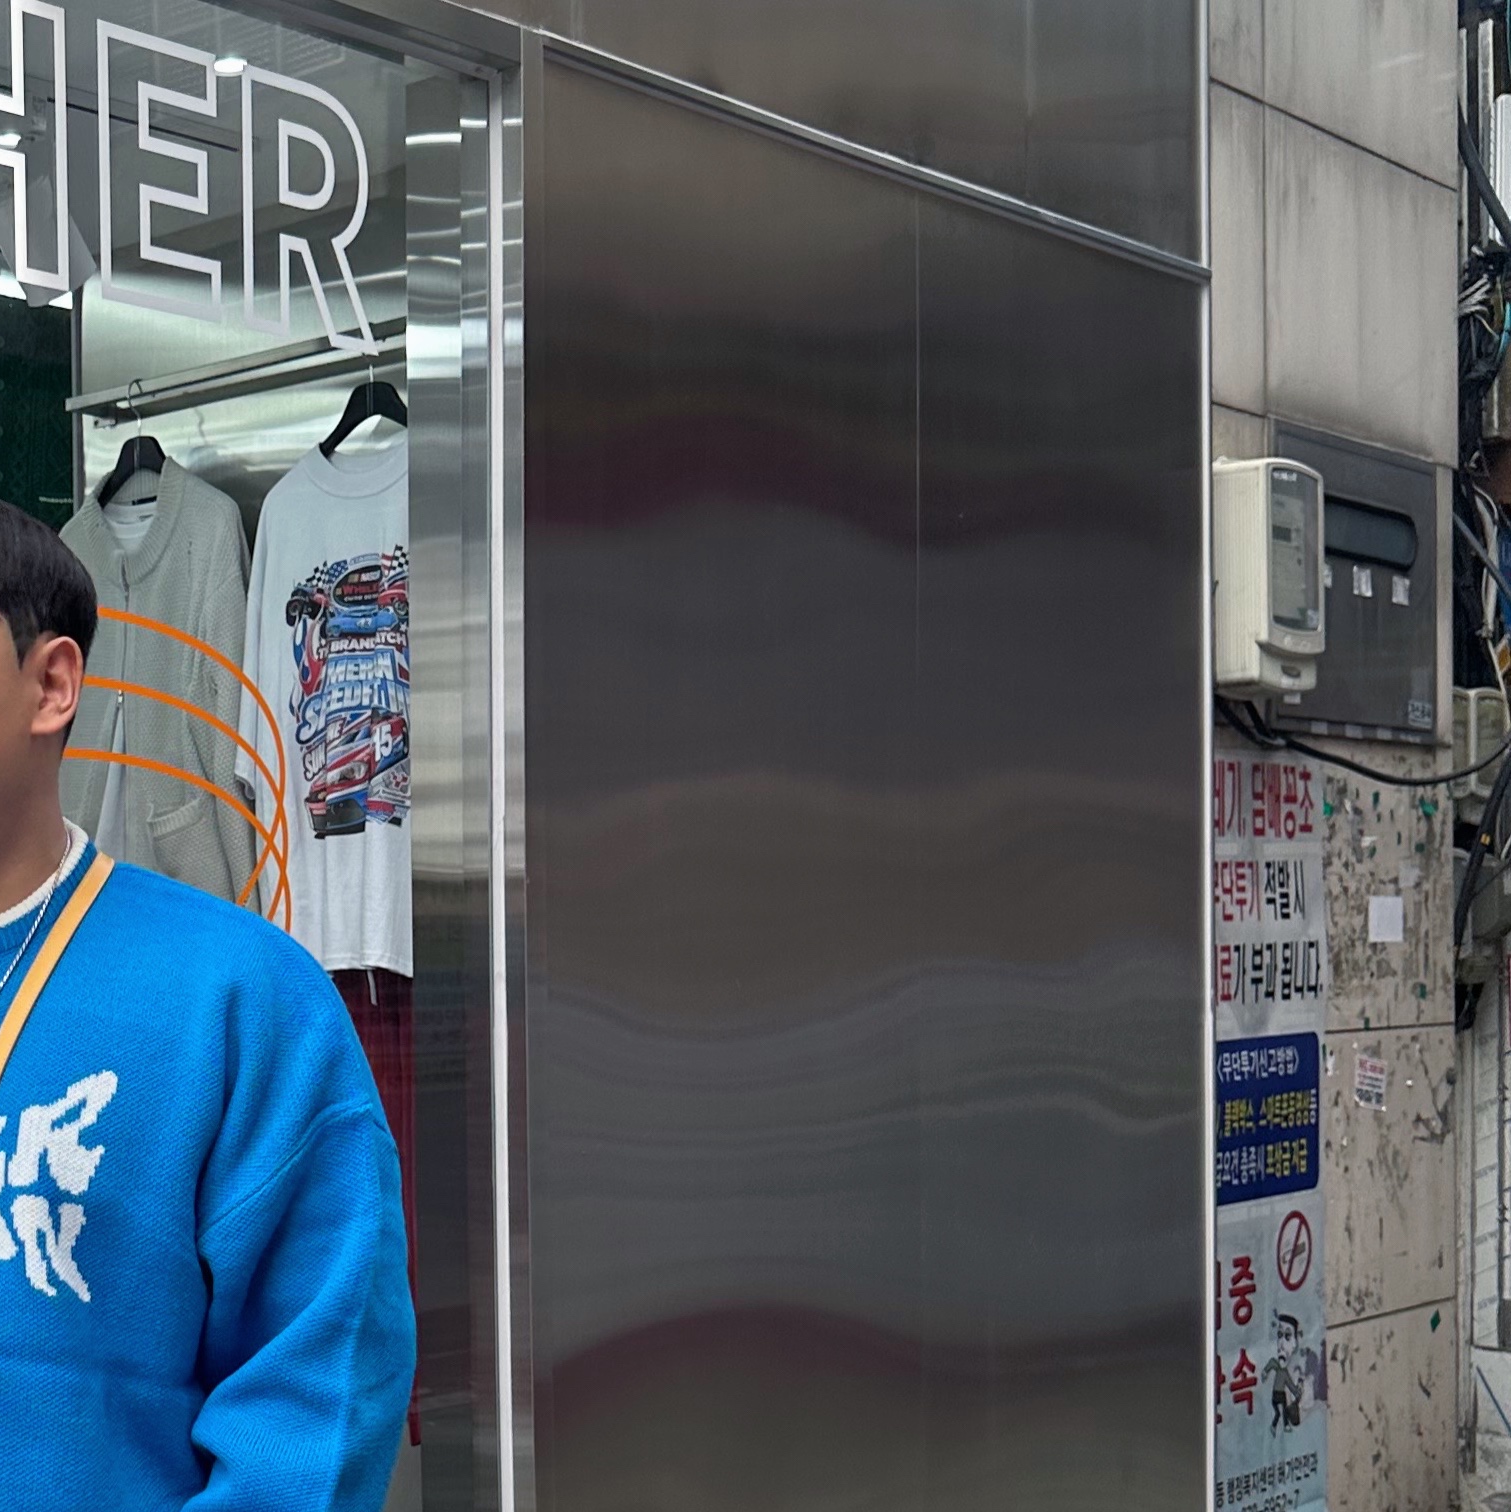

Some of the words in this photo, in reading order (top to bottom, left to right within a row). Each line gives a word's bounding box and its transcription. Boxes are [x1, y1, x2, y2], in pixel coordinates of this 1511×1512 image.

[374, 722, 393, 763] 15
[1252, 762, 1315, 840] 담배꽁초
[1215, 1255, 1257, 1331] 중
